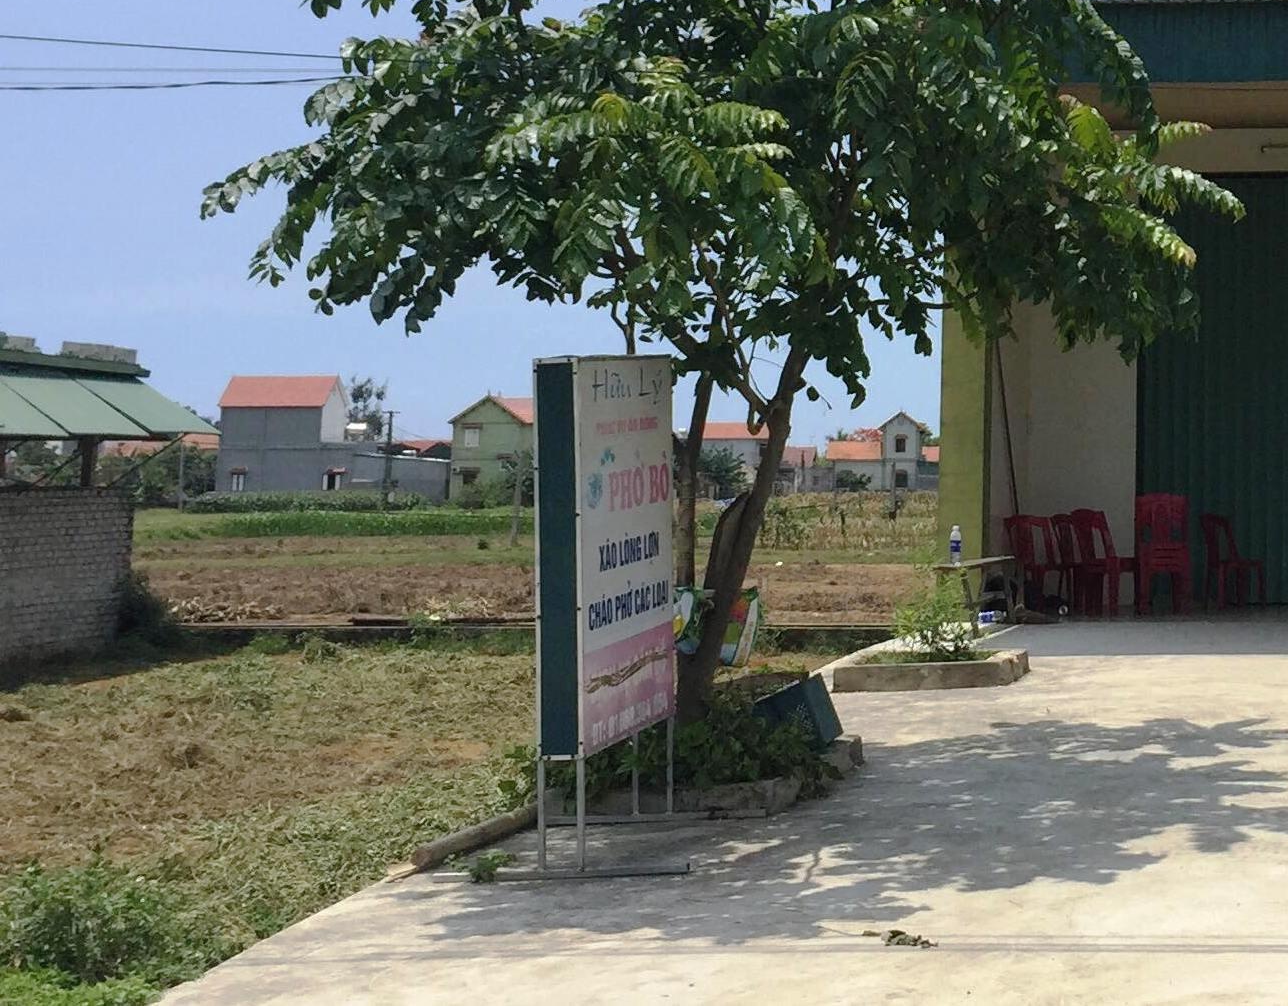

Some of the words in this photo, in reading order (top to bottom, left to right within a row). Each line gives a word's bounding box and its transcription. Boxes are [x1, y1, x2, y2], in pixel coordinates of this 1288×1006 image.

[599, 538, 617, 573] XÁO
[619, 532, 642, 567] LÒNG
[589, 593, 613, 631] CHÁO
[615, 580, 633, 622] PHỞ
[634, 582, 651, 615] CÁC
